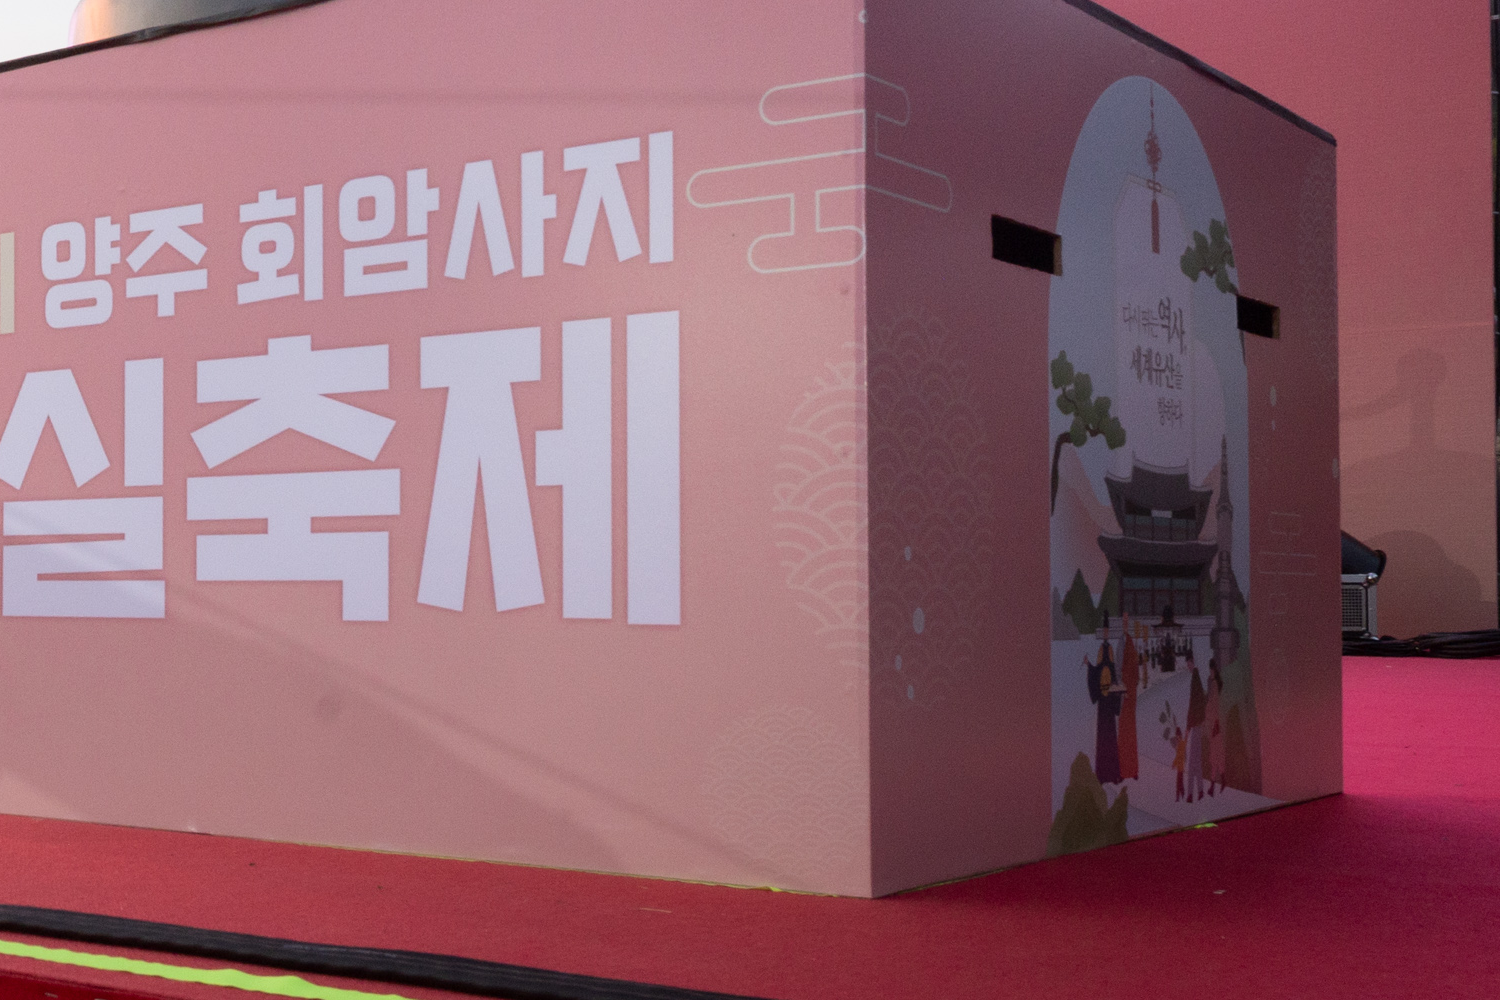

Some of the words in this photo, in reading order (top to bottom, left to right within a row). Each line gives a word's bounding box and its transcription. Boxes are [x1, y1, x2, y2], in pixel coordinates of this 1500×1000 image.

[41, 203, 210, 330] 양주
[237, 131, 675, 306] 회암사지
[1130, 345, 1184, 391] 세계유산을
